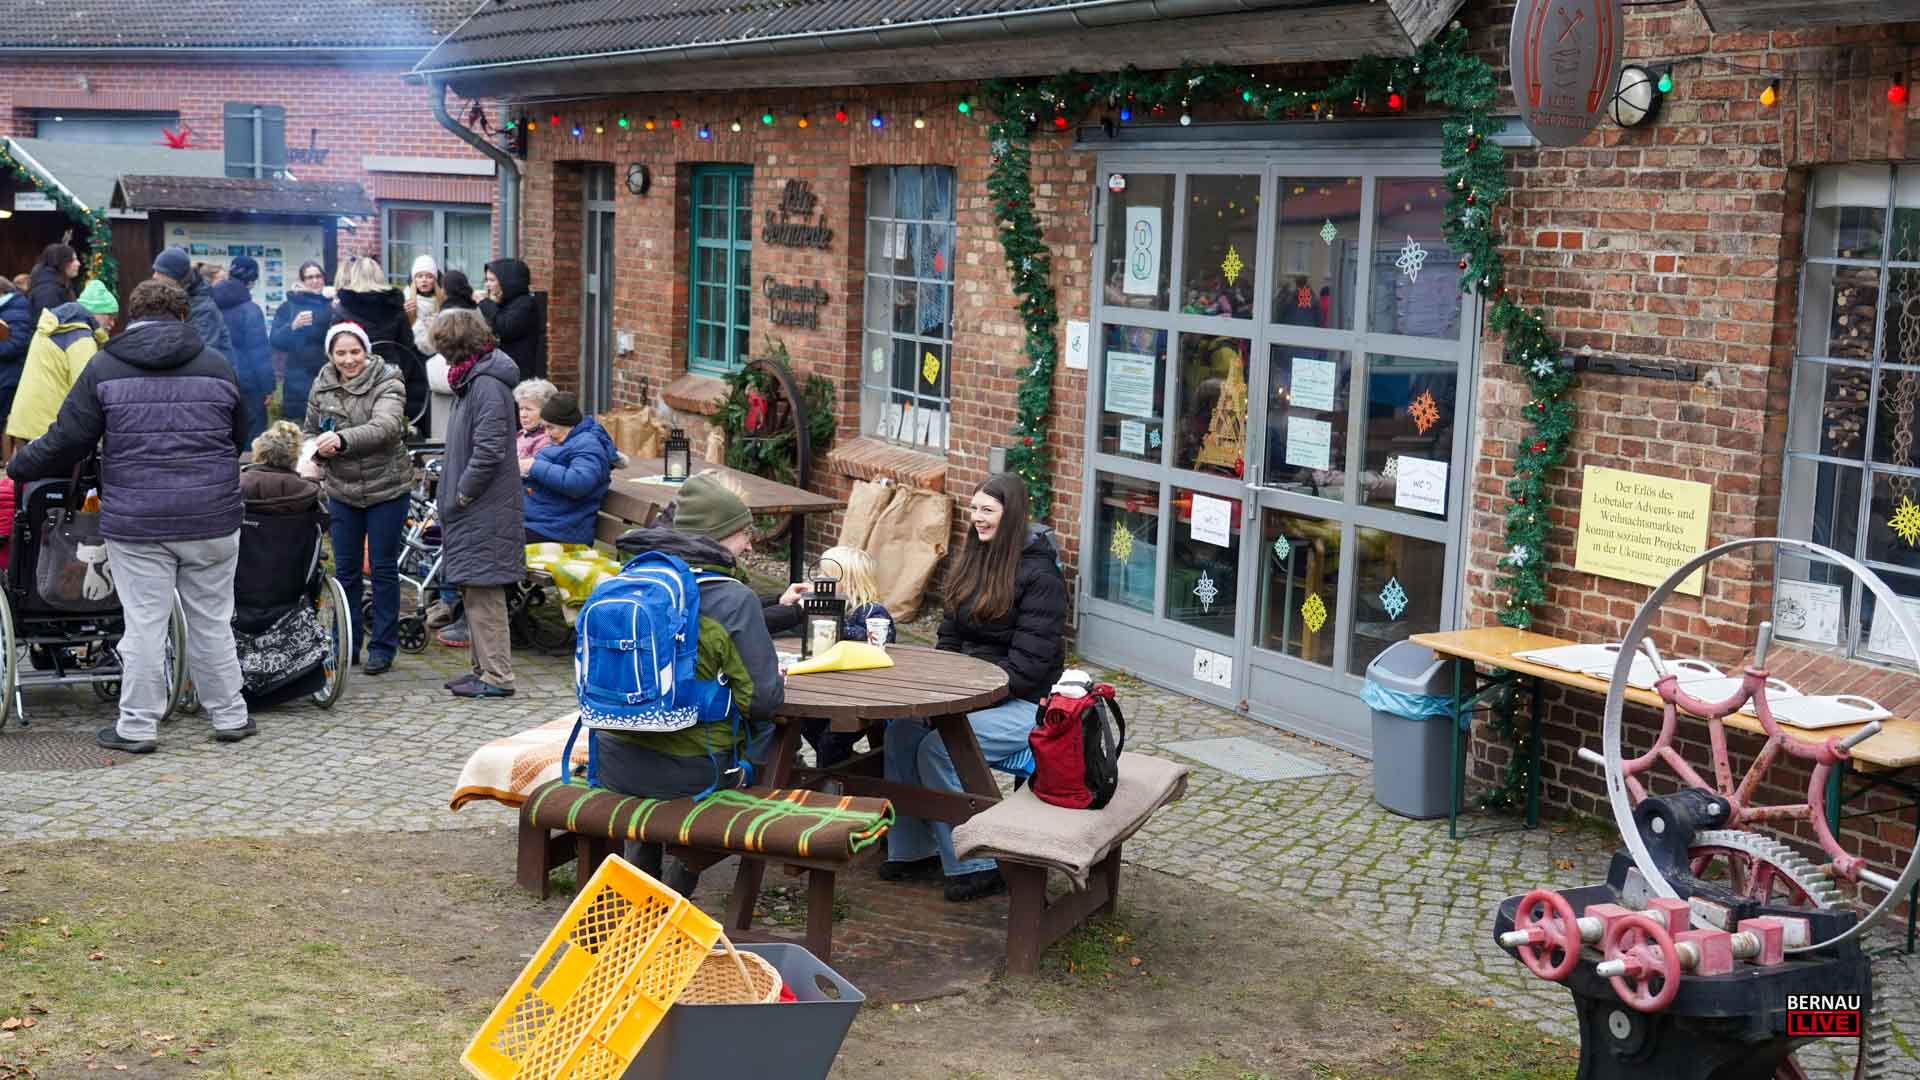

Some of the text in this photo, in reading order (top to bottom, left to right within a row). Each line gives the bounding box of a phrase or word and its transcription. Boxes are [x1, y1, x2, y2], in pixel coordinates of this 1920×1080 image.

[1615, 480, 1674, 500] Der Erlös des
[1593, 492, 1695, 520] Lobetaler Advents- und
[1600, 510, 1684, 534] Weihnachtsmarktes
[1585, 522, 1697, 554] kommt sozialen Projekten
[1593, 542, 1601, 552] in
[1603, 543, 1617, 555] der
[1619, 546, 1654, 562] Ukraine
